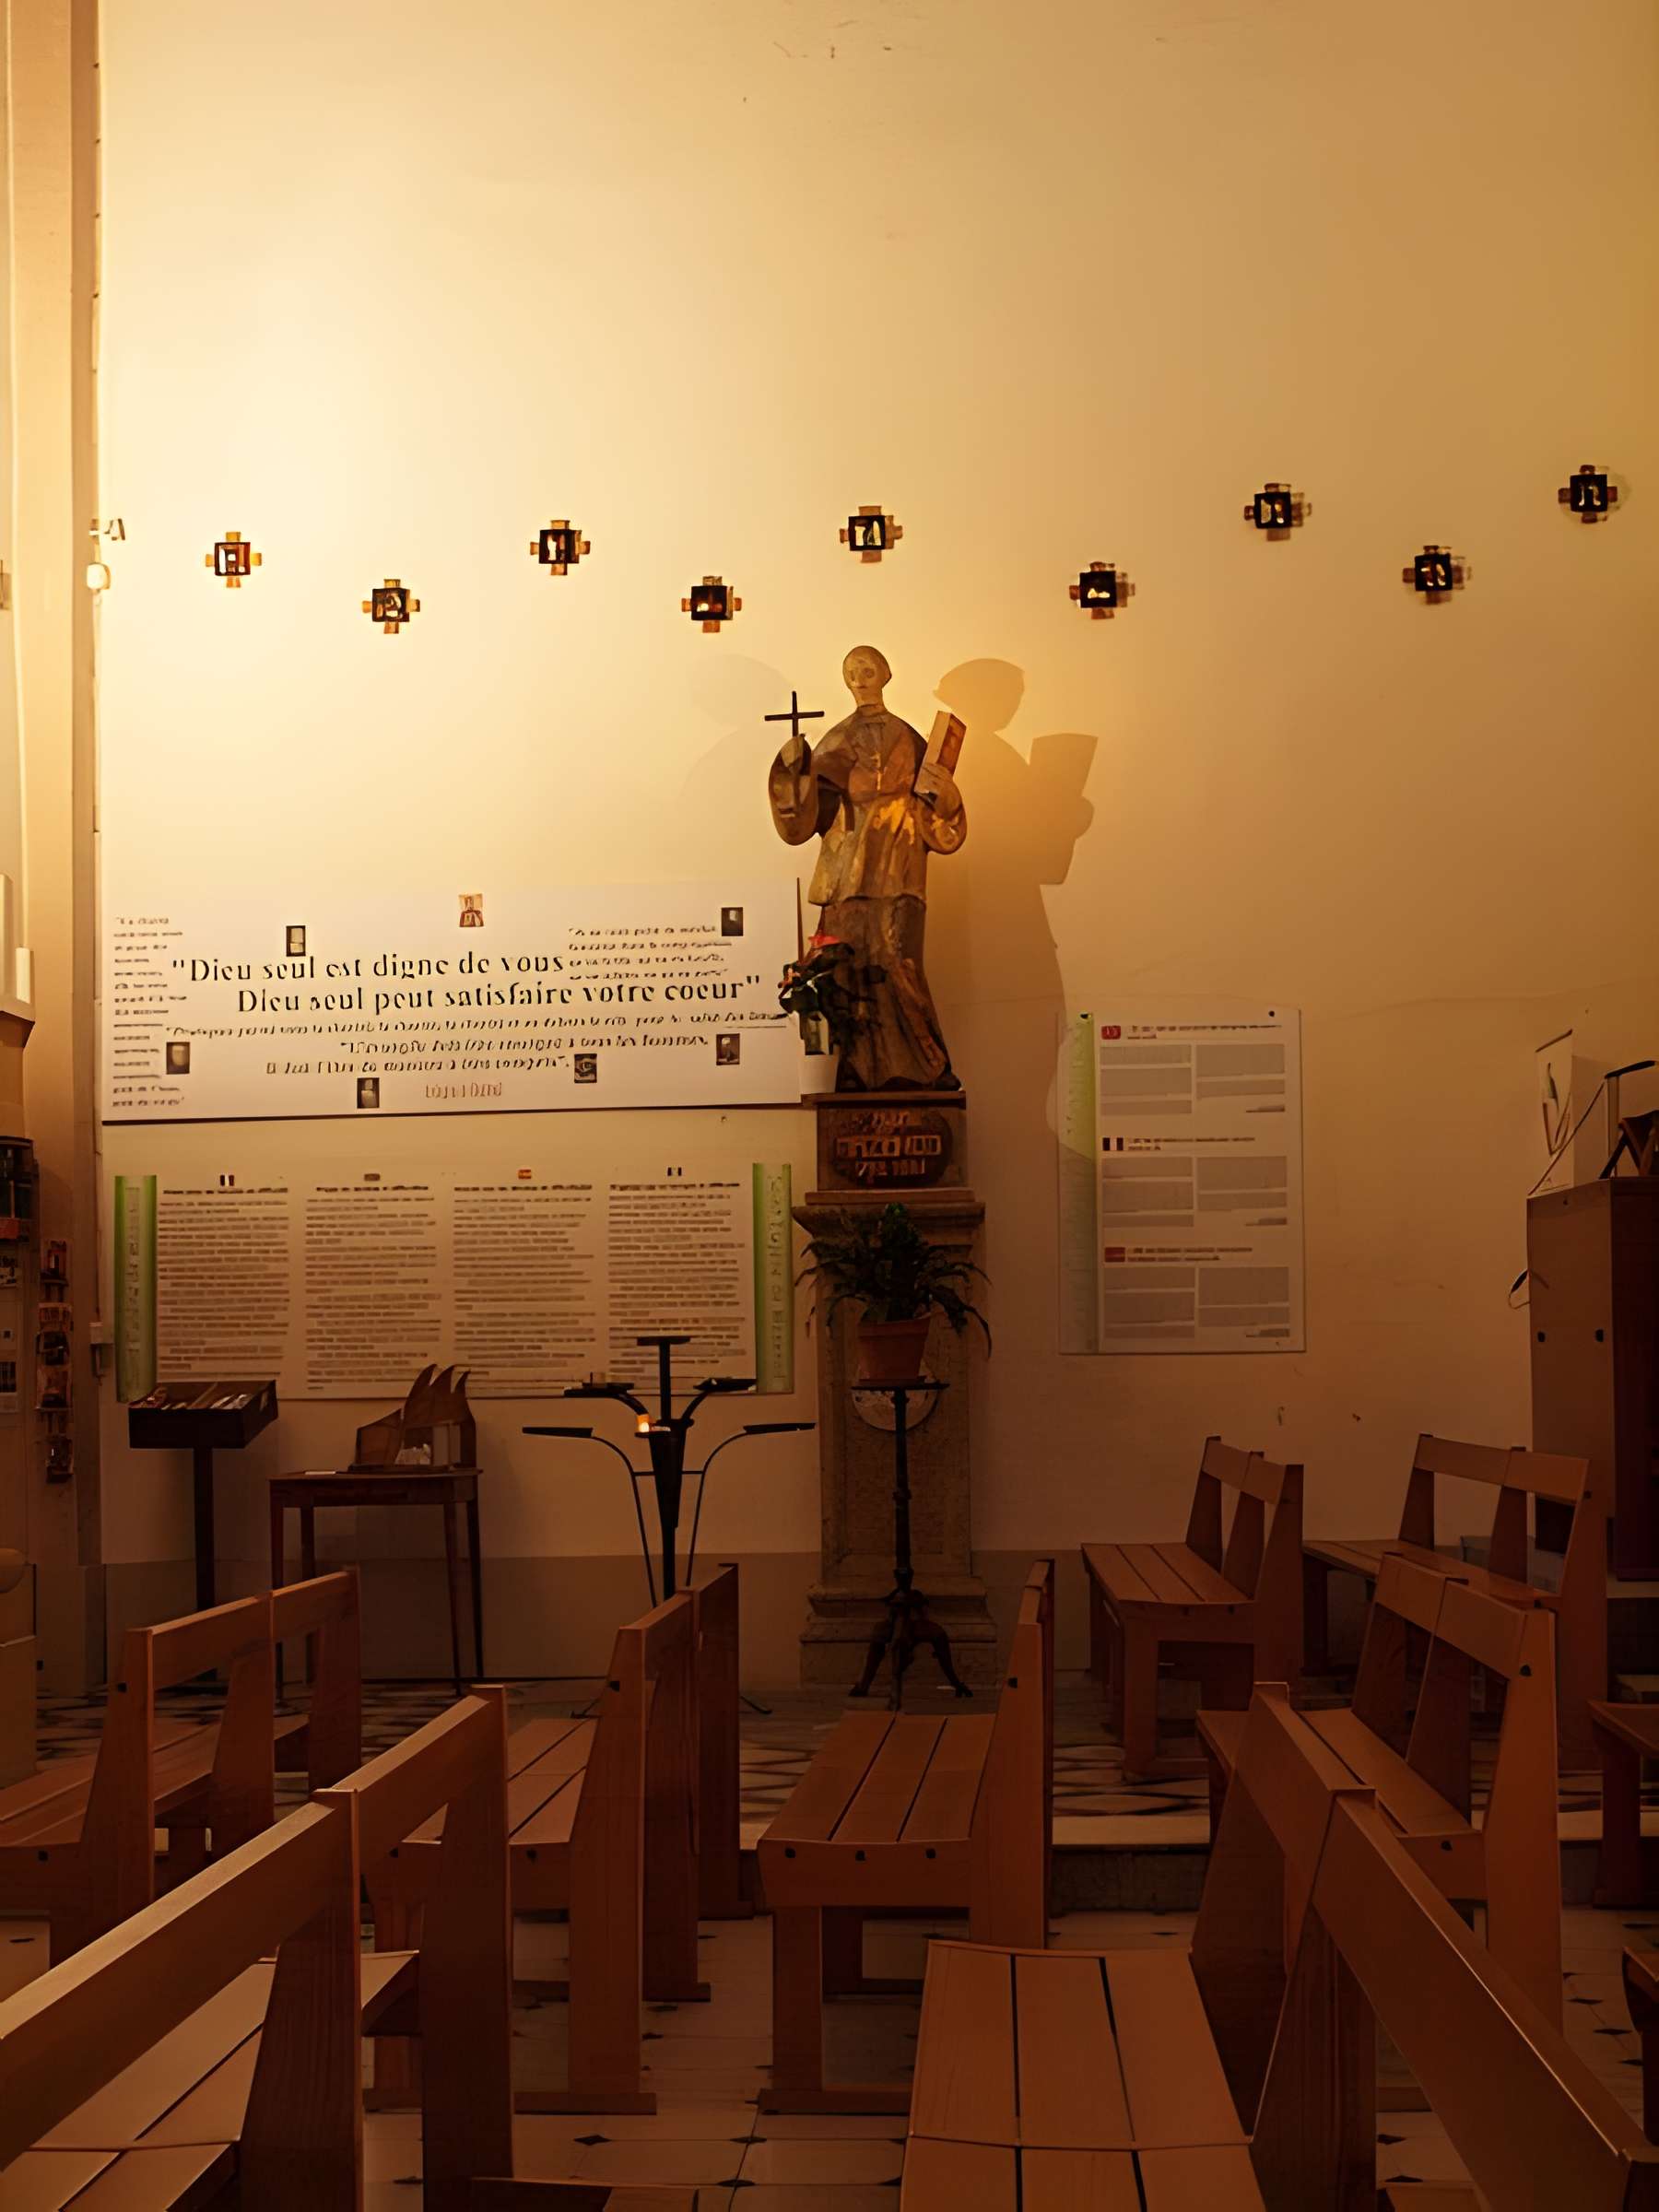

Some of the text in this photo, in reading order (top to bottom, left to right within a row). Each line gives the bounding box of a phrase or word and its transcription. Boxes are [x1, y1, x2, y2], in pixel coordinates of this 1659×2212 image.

[263, 956, 314, 979] seul
[326, 959, 361, 978] est
[373, 953, 449, 980] digne
[459, 951, 490, 974] de
[500, 957, 564, 973] vous
[238, 989, 300, 1013] Dieu
[310, 987, 363, 1010] seul
[375, 991, 433, 1016] peut
[445, 981, 572, 1006] satisfaire
[582, 984, 653, 1003] votre
